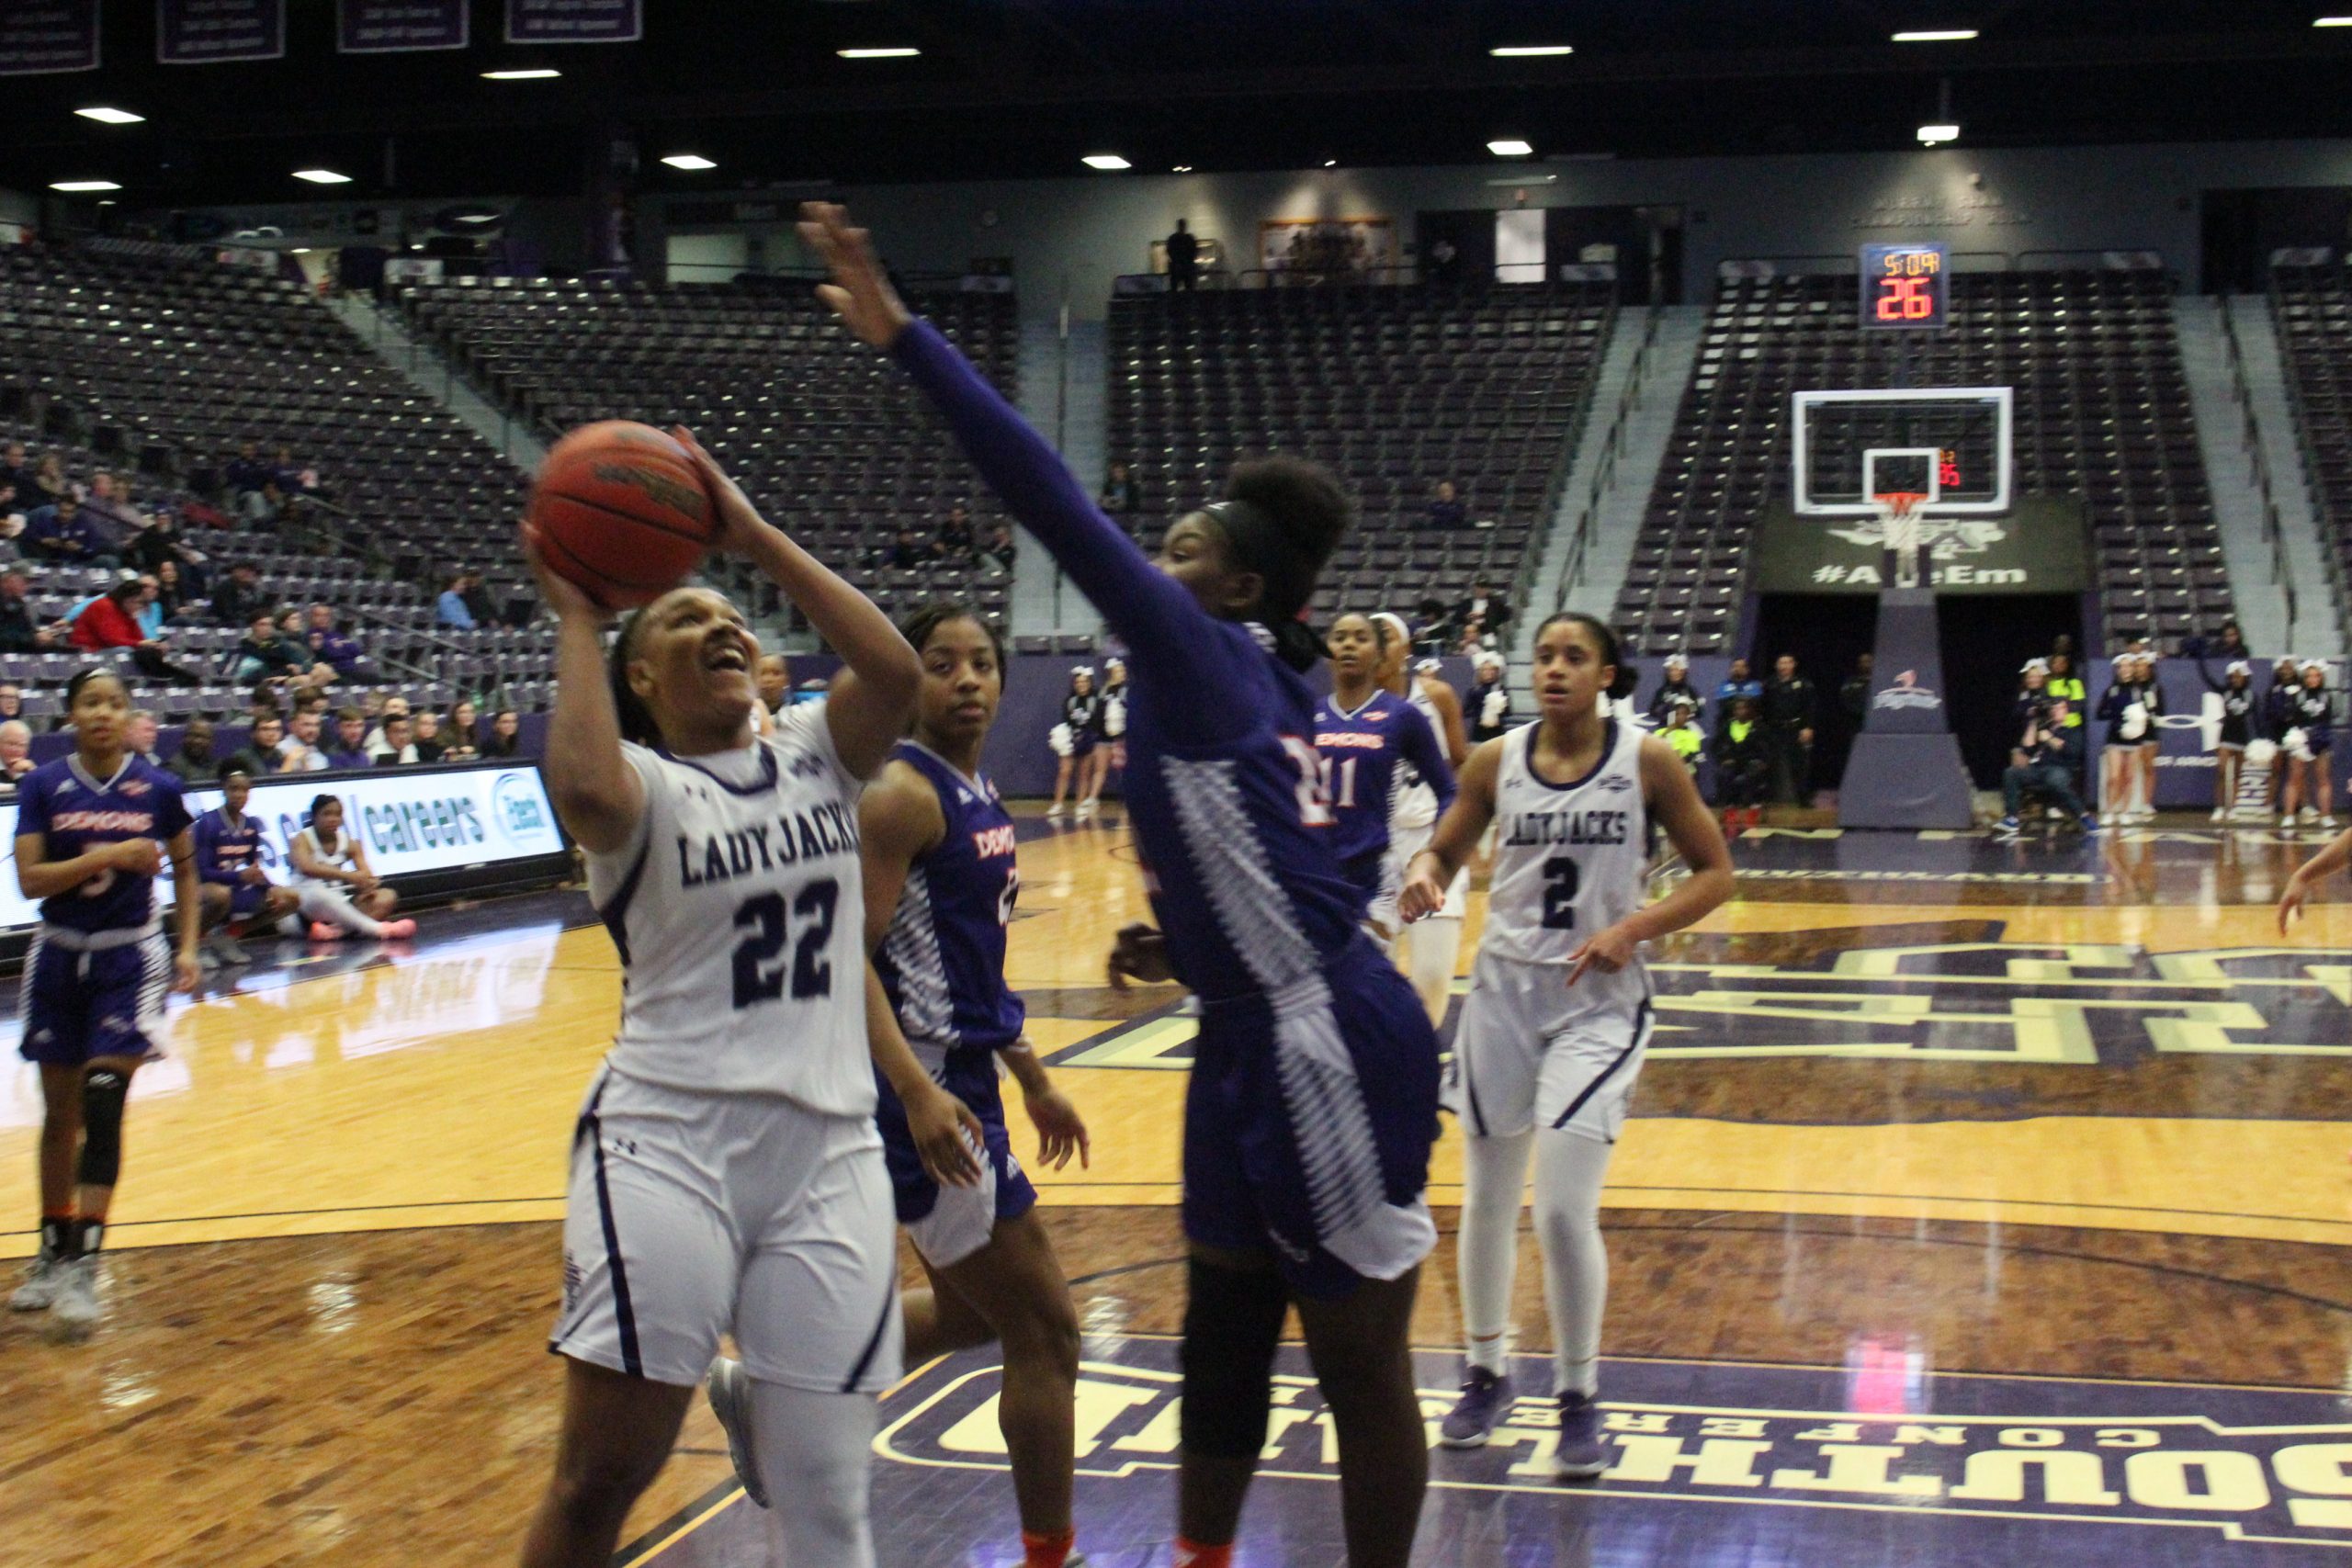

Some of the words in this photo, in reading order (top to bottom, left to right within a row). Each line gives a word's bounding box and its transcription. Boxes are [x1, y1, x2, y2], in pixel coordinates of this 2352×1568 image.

[1884, 253, 1940, 276] 5:09
[1877, 277, 1933, 320] 26
[1812, 565, 2028, 585] #AEm
[1313, 732, 1385, 749] EMONS
[1555, 810, 1628, 846] JACKS
[677, 823, 775, 889] LADY
[1542, 856, 1578, 930] 2
[732, 876, 839, 1011] 22
[938, 1379, 2352, 1529] SOUTHLND
